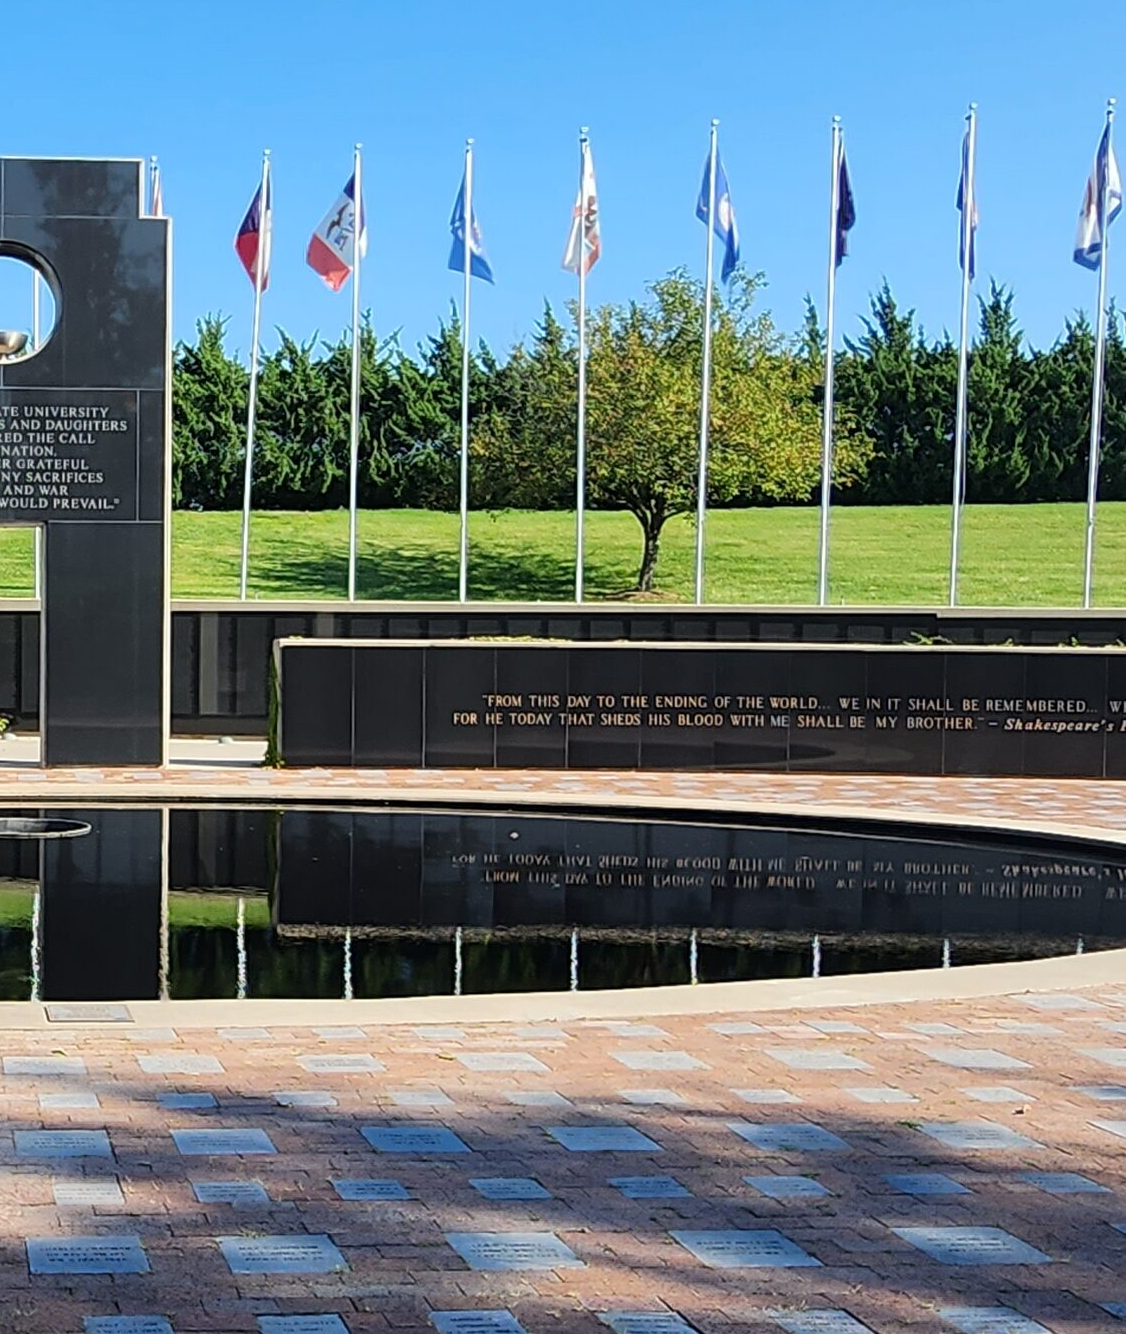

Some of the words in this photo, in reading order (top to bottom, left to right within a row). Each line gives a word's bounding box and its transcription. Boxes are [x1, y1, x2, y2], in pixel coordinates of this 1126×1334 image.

[24, 405, 109, 418] UNIVERSITY
[11, 418, 40, 431] AND
[45, 418, 127, 431] DAUGHTERS
[27, 431, 53, 444] THE
[59, 431, 95, 444] CALL
[16, 457, 89, 470] GRATEFUL
[26, 471, 103, 483] SACRIFICES
[4, 483, 32, 496] AND
[38, 483, 68, 496] WAR
[529, 695, 560, 708] THIS
[568, 695, 591, 708] DAY
[597, 695, 615, 709] TO
[622, 695, 648, 709] THE
[656, 695, 707, 709] ENDING
[714, 696, 732, 709] OF
[737, 696, 764, 709] THE
[840, 697, 860, 710] WE
[867, 697, 880, 710] IN
[888, 697, 902, 710] IT
[908, 698, 954, 711] SHALL
[962, 699, 980, 711] BE
[453, 713, 478, 725] FOR
[486, 713, 504, 725] HE
[510, 713, 552, 725] TODAY
[558, 713, 595, 725] THAT
[600, 713, 641, 726] SHEDS
[648, 713, 670, 726] HIS
[678, 713, 723, 727] BLOOD
[730, 714, 764, 727] WITH
[770, 715, 790, 727] ME
[797, 715, 844, 728] SHALL
[850, 716, 866, 729] BE
[876, 716, 898, 729] MY
[1004, 718, 1114, 733] Shakespeare's
